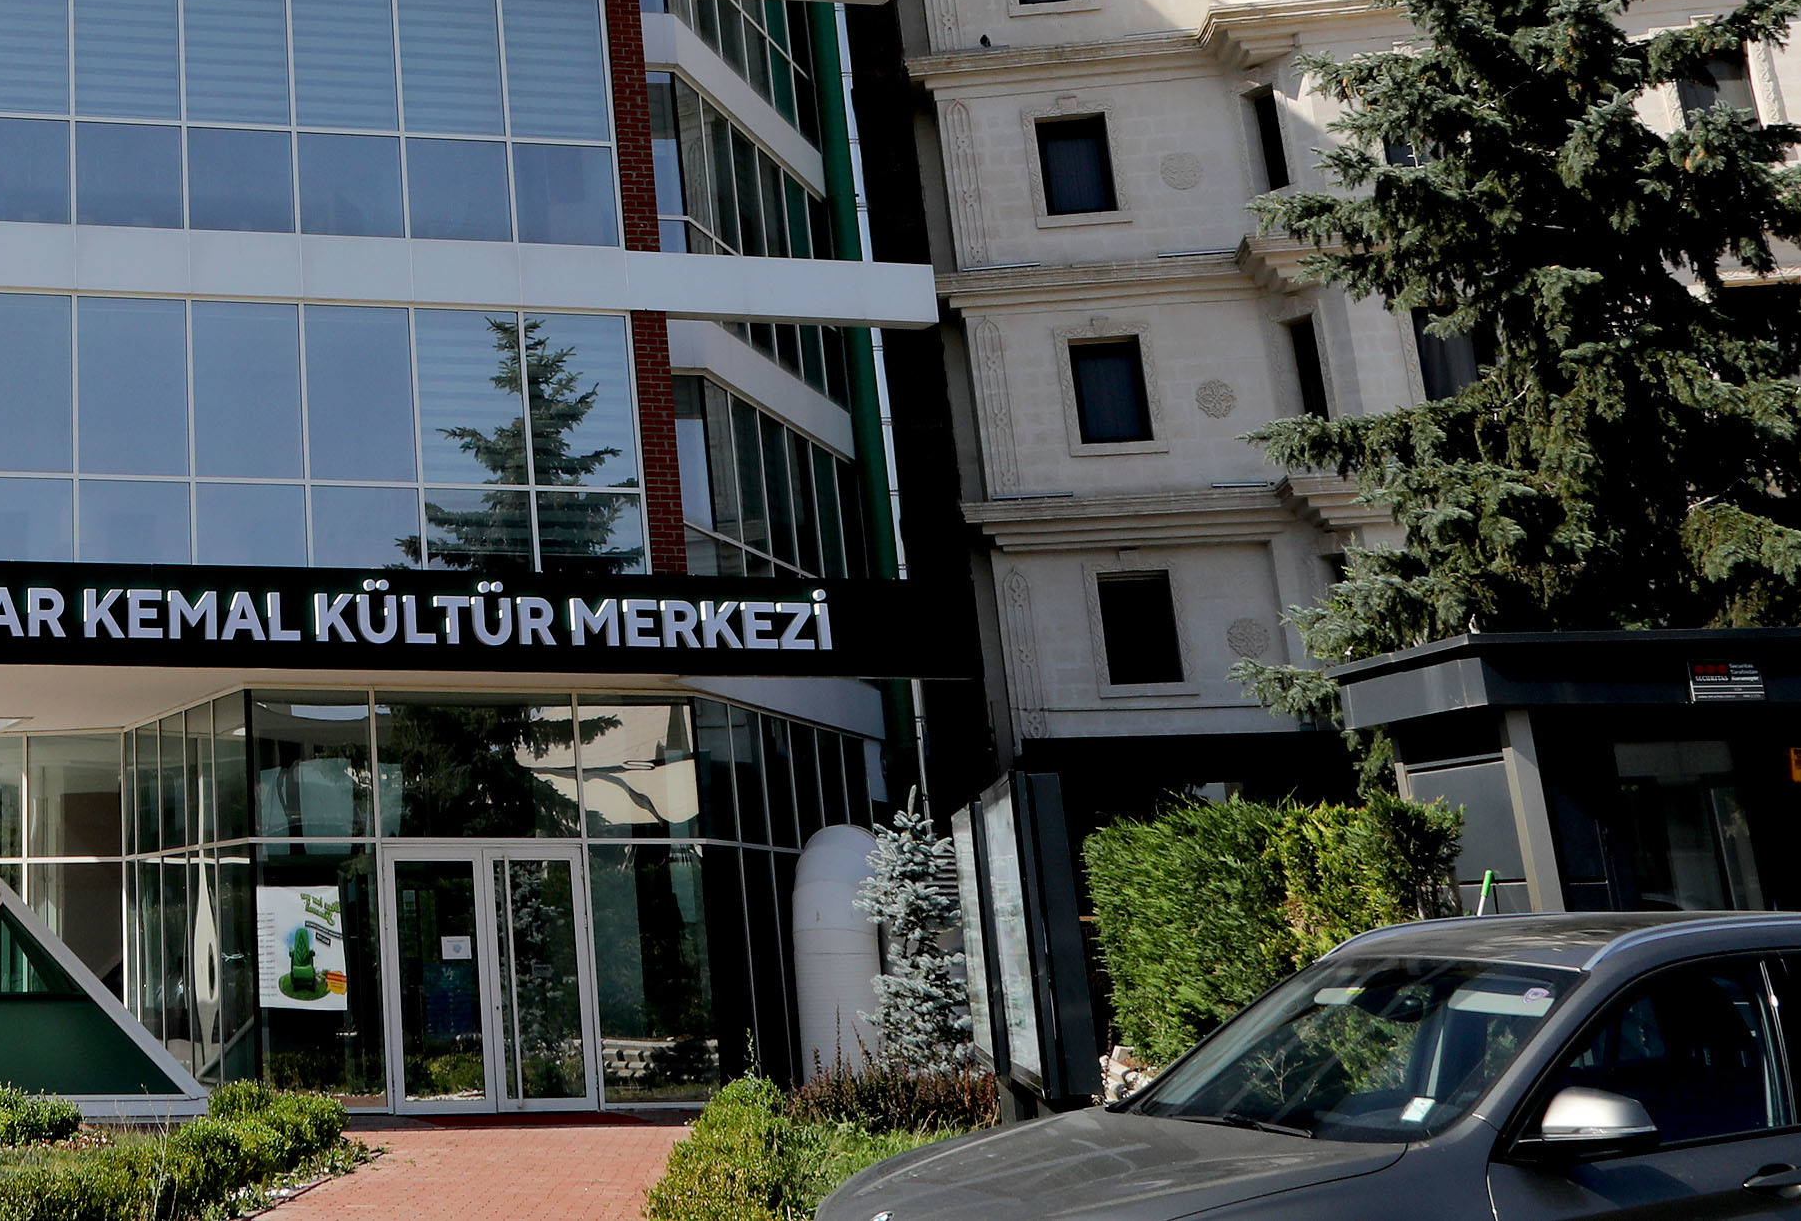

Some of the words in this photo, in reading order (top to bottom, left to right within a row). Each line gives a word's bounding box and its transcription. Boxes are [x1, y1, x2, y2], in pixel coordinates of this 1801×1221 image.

[83, 588, 301, 641] KEMAL
[313, 579, 557, 646] KÜLTÜR
[568, 588, 833, 650] MERKEZİ
